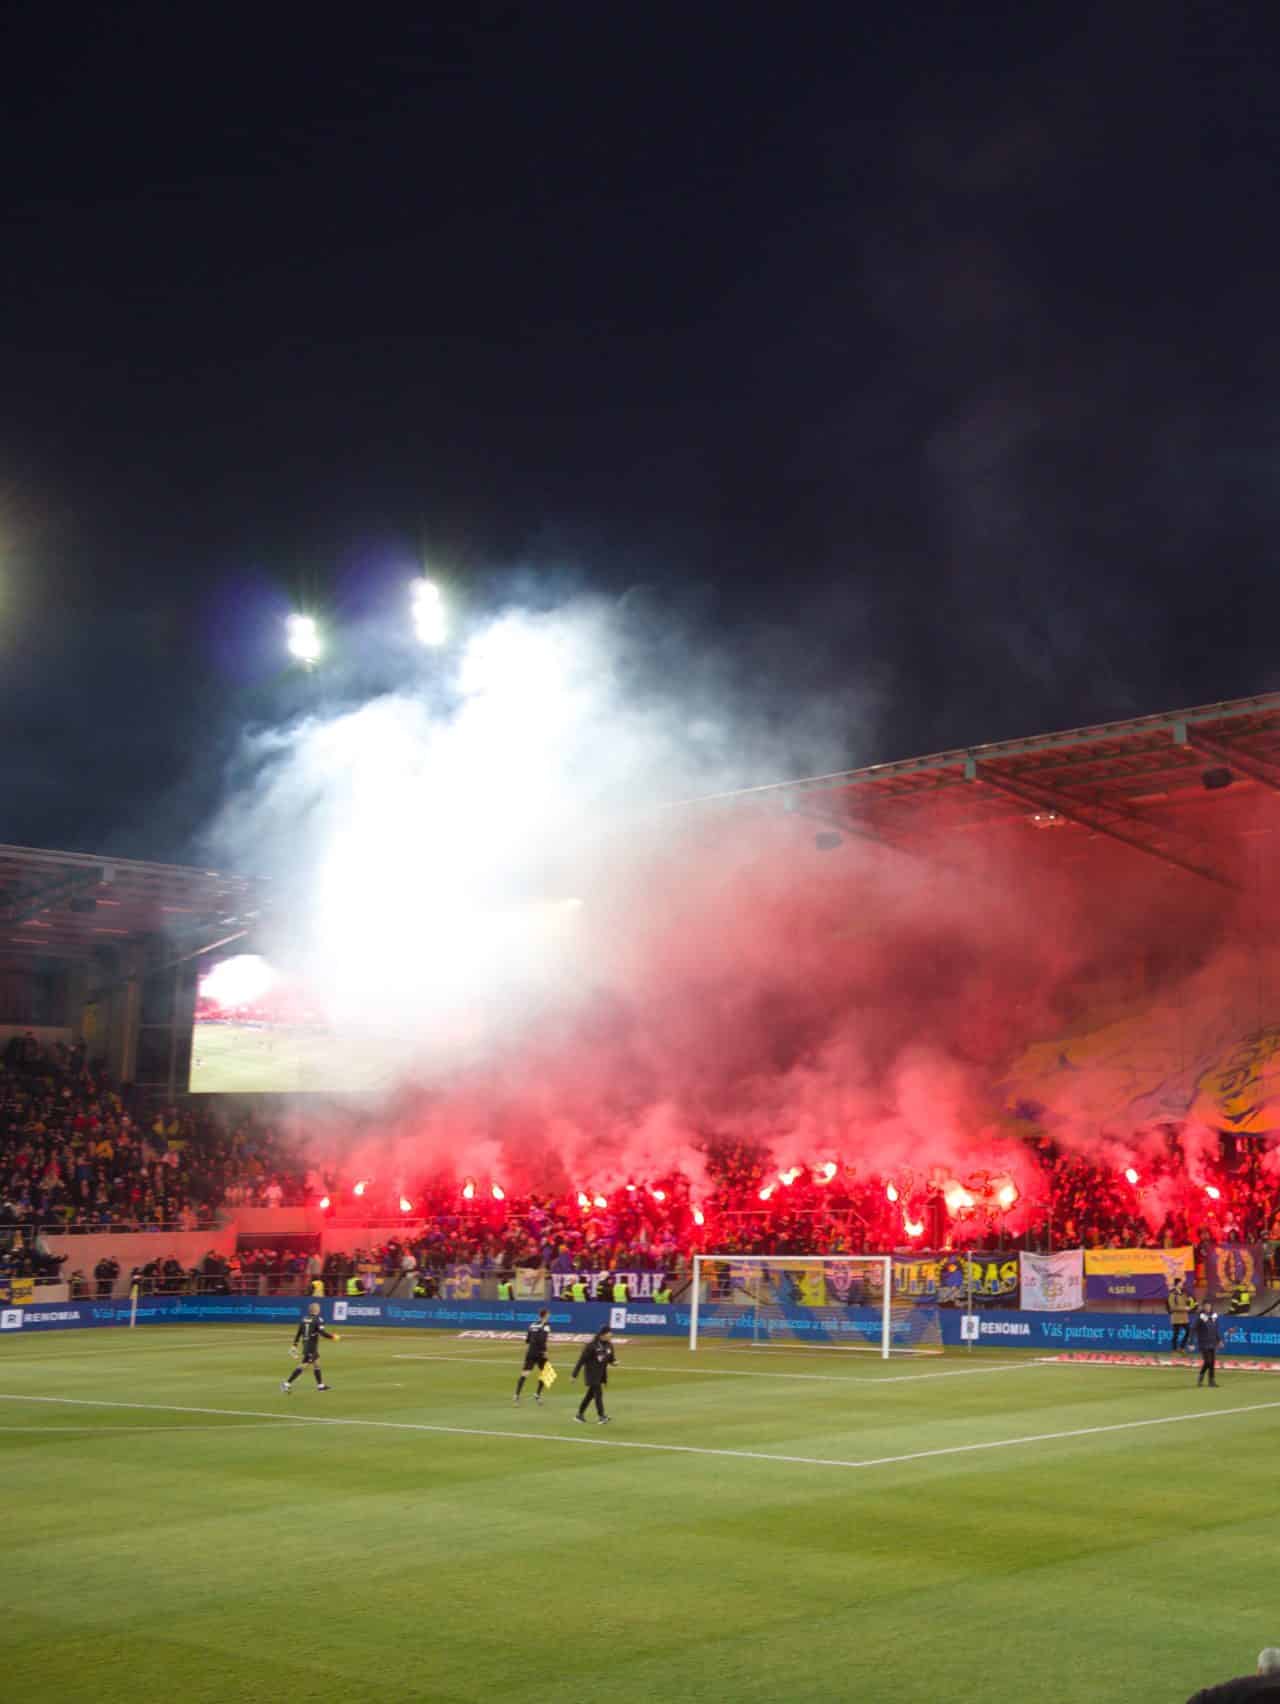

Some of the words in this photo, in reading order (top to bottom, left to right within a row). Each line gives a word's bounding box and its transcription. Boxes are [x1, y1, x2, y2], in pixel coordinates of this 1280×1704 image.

[980, 1322, 1030, 1335] RENOMIA
[1041, 1322, 1063, 1337] Váš
[1064, 1324, 1105, 1342] partner
[1107, 1329, 1116, 1338] v
